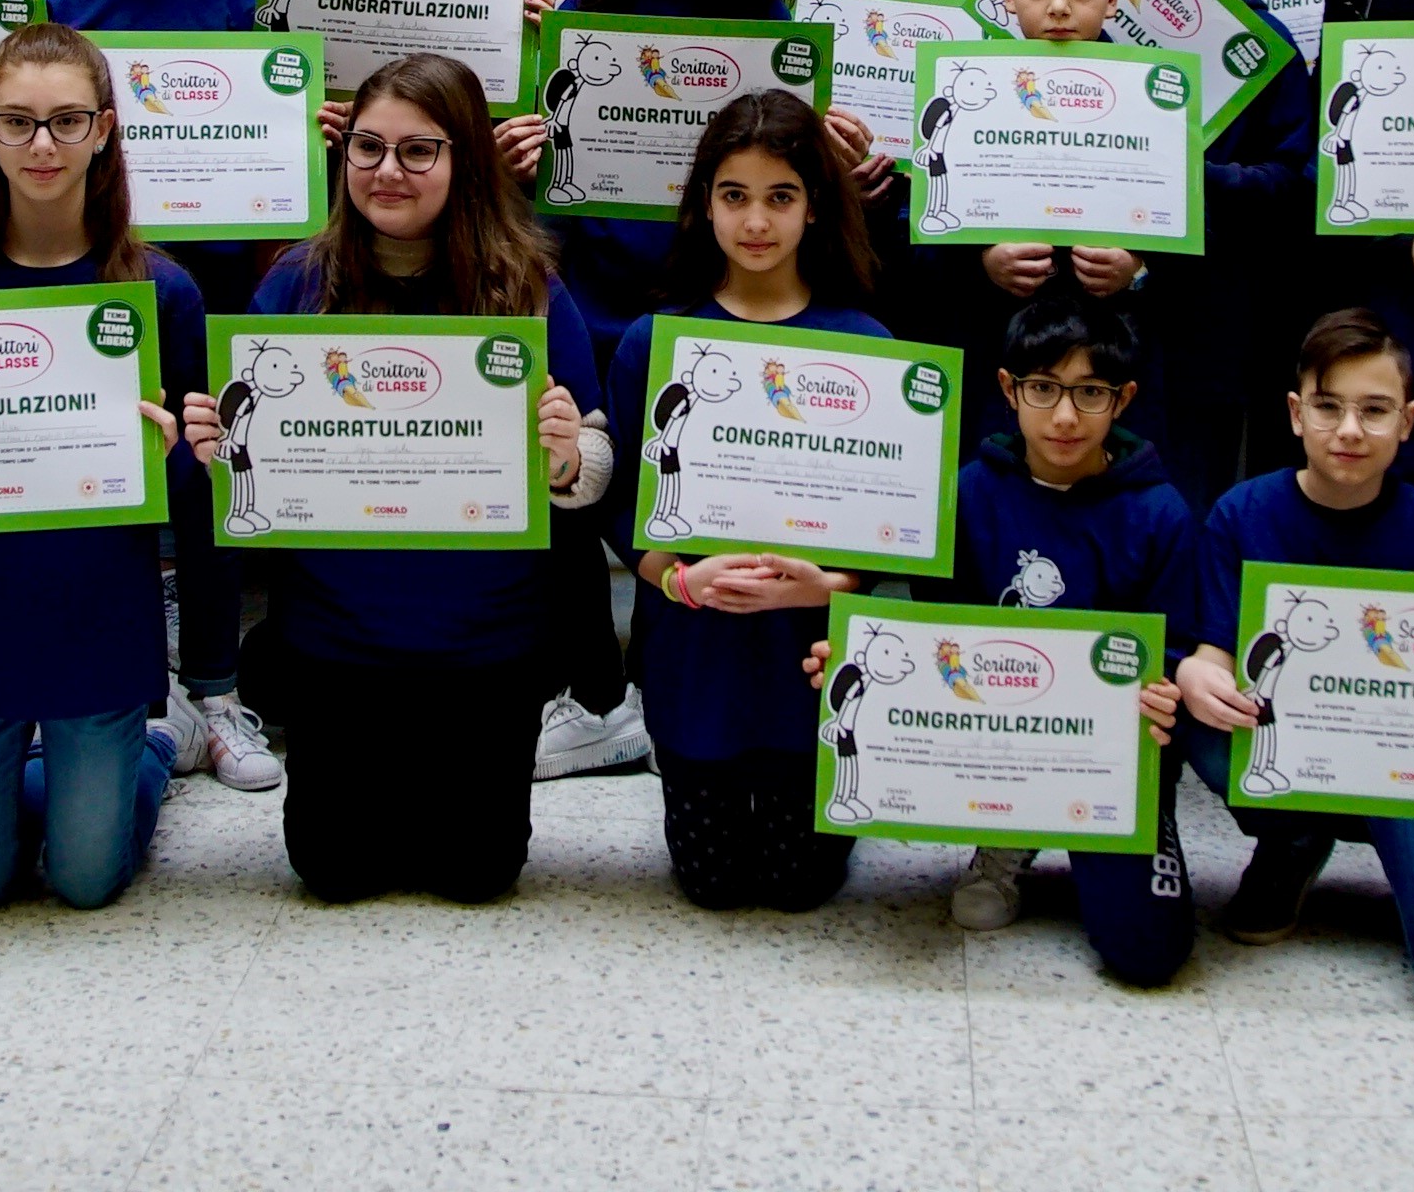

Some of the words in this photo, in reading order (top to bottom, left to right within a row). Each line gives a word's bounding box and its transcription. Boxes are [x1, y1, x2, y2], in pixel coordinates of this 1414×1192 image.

[892, 21, 943, 40] Scrittori
[671, 57, 728, 75] Scrittori
[781, 55, 813, 68] TEMPO
[779, 65, 811, 78] LIBERO
[161, 72, 219, 88] Scrittori
[671, 74, 681, 85] di
[684, 76, 727, 87] CLASSE
[175, 90, 219, 100] CLASSE
[1046, 80, 1104, 96] Scrittori
[1060, 98, 1103, 108] CLASSE
[973, 130, 1151, 148] CONGRATULAZIONI!
[97, 323, 133, 334] TEMPO
[96, 335, 133, 346] LIBERO
[486, 353, 523, 366] TEMPO
[361, 360, 427, 379] Scrittori
[485, 365, 522, 378] LIBERO
[362, 380, 373, 393] di
[377, 381, 426, 393] CLASSE
[796, 374, 857, 398] Scrittori
[809, 396, 856, 411] CLASSE
[280, 419, 482, 438] CONGRATULAZIONI!
[713, 424, 903, 460] CONGRATULAZIONI!
[973, 652, 1040, 674] Scrittori
[988, 674, 1039, 688] CLASSE
[888, 707, 1093, 737] CONGRATULAZIONI!
